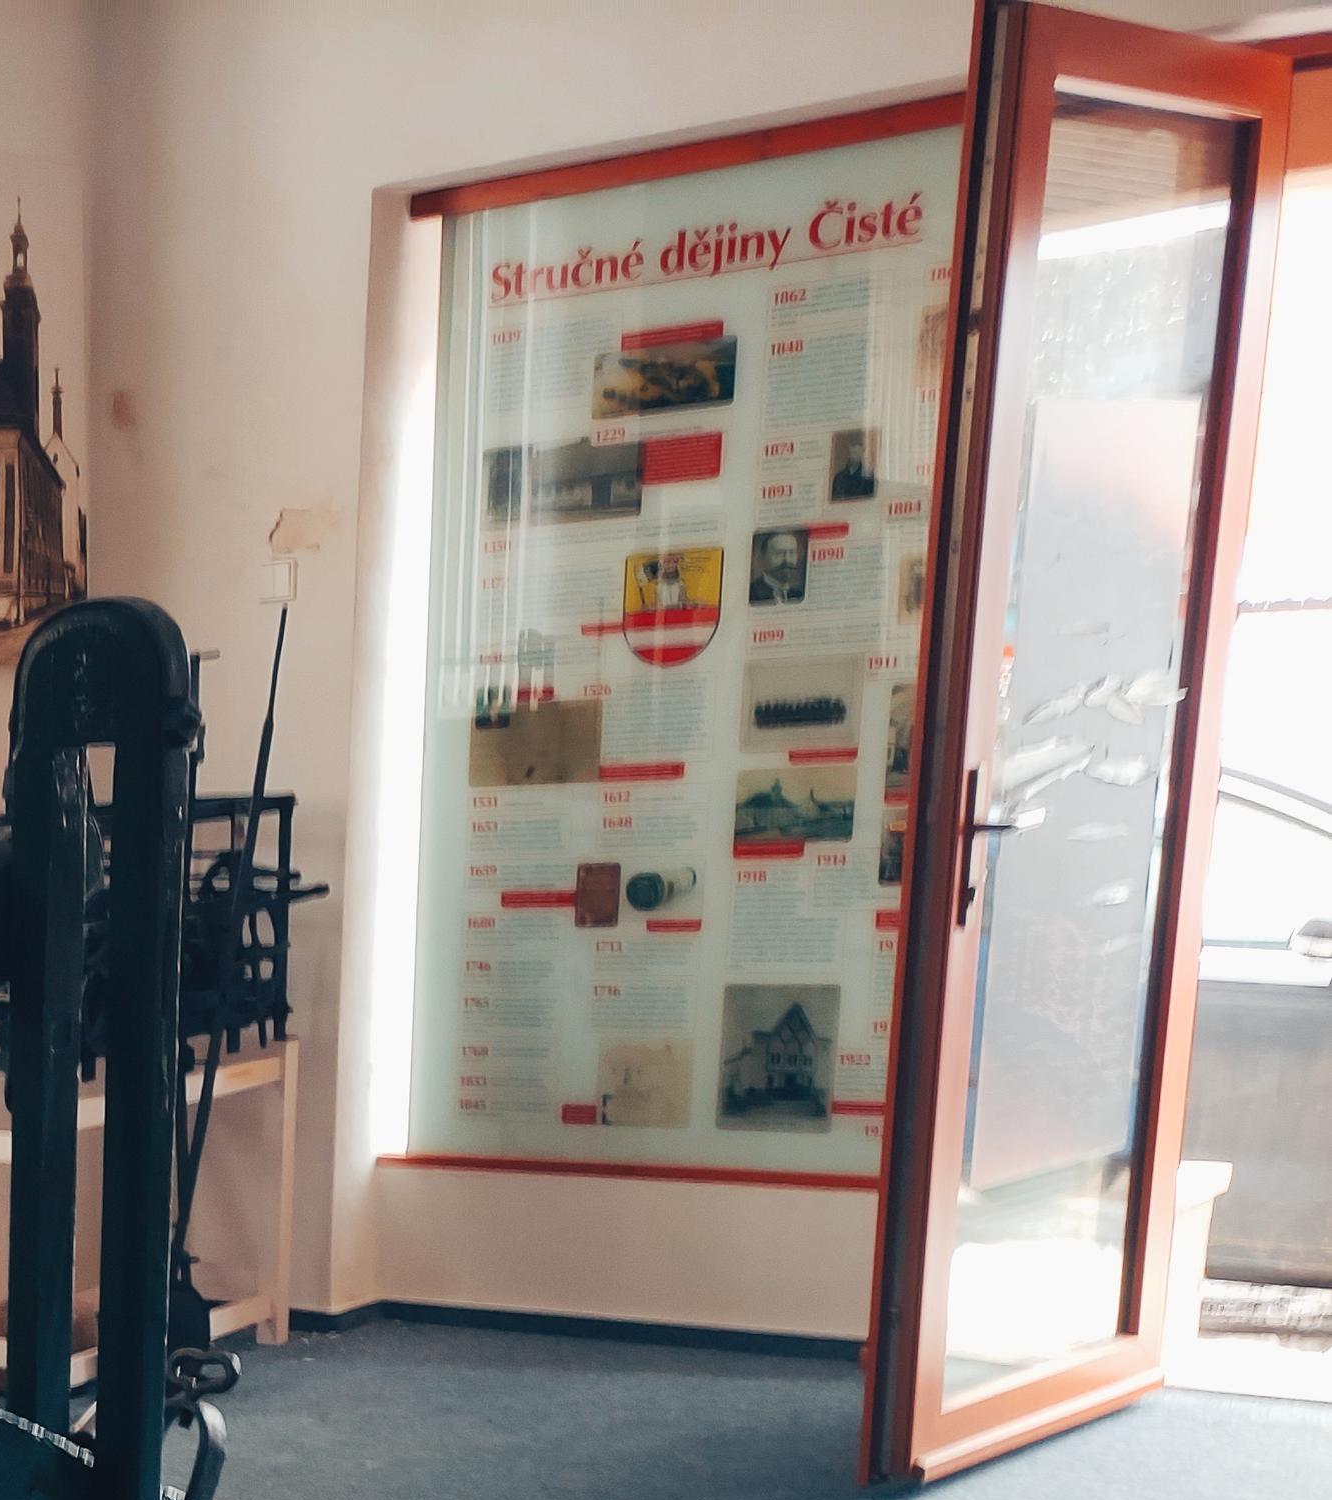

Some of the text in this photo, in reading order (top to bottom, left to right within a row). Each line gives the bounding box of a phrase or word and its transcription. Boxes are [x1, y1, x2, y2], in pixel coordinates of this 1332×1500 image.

[490, 192, 925, 301] Stručné dějiny Čisté
